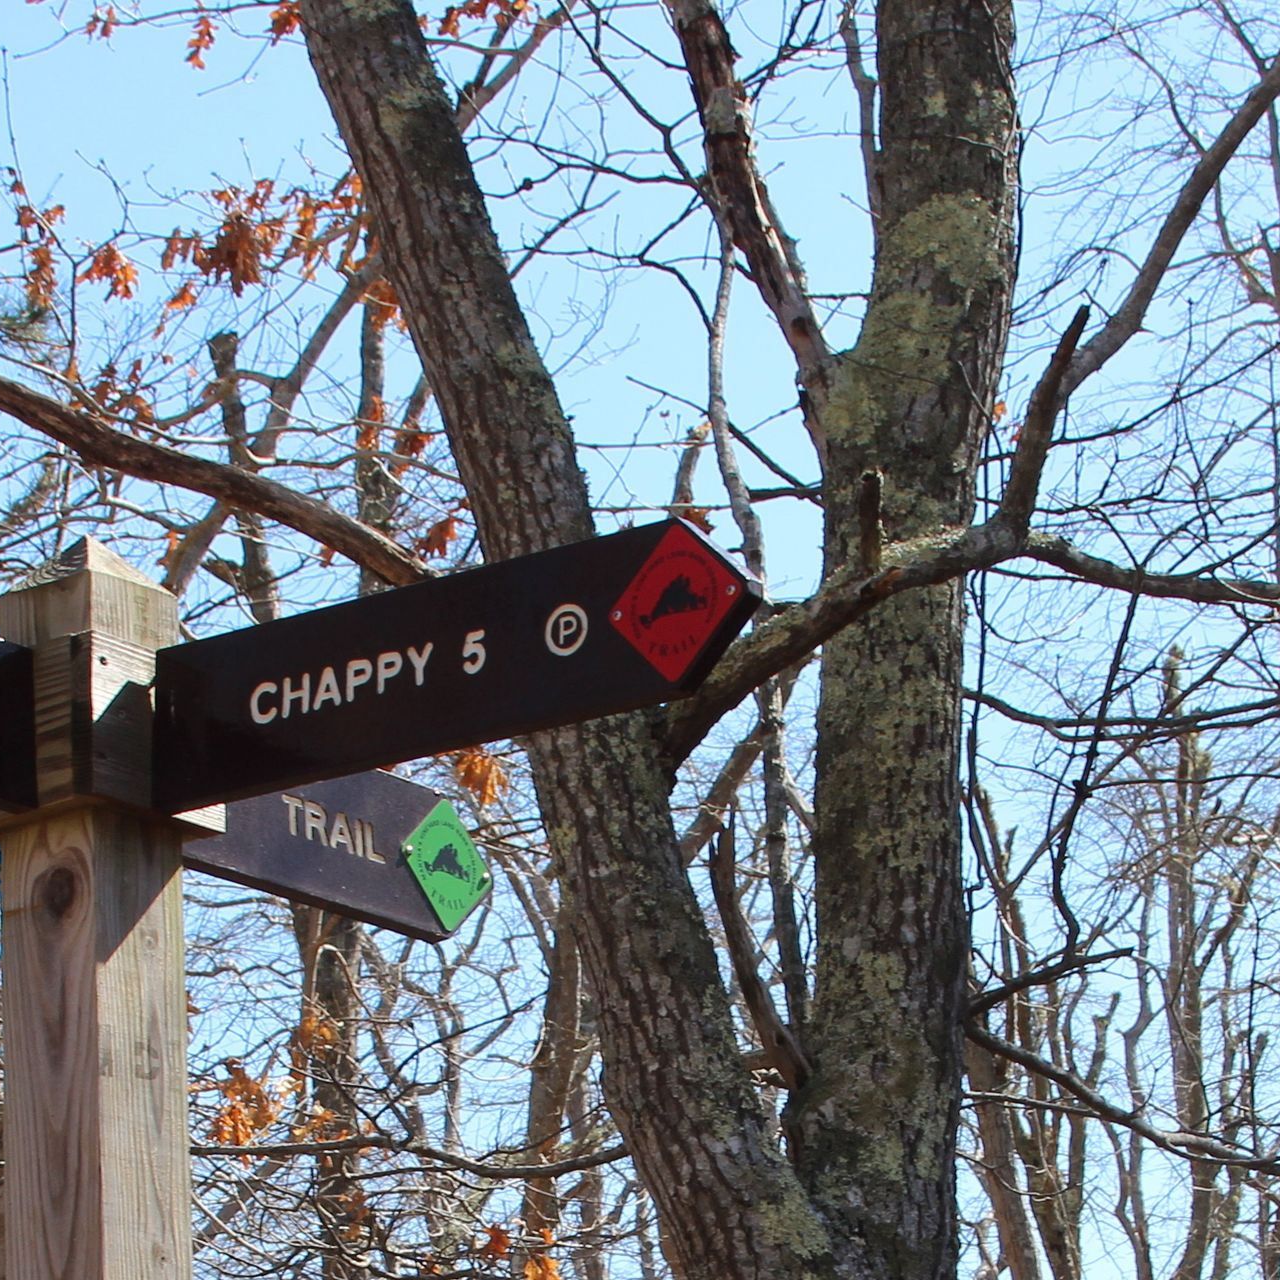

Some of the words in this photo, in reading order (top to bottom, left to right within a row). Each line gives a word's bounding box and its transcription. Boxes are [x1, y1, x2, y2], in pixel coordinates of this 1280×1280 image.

[250, 642, 434, 724] CHAPPY
[462, 629, 486, 675] 5
[281, 793, 386, 865] TRAIL
[431, 888, 465, 910] TRAIL
